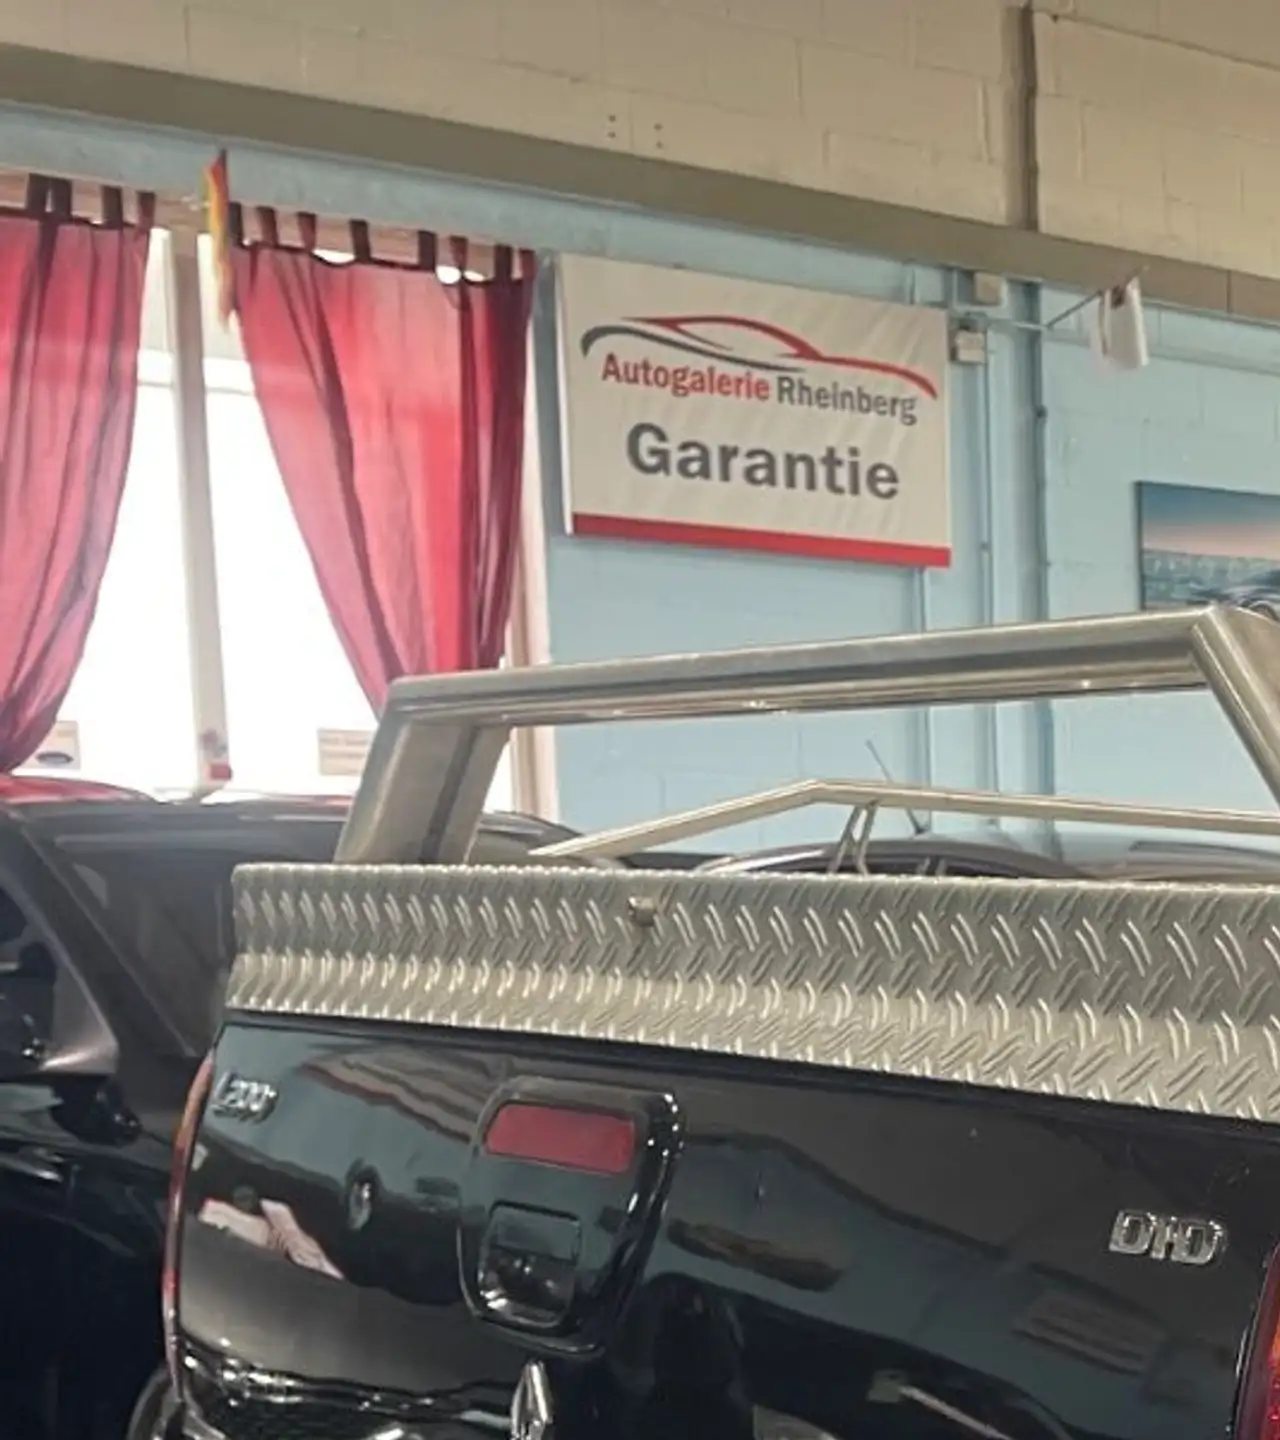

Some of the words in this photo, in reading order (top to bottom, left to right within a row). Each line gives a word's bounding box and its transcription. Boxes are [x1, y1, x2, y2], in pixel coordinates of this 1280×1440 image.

[601, 352, 770, 402] Autogalerie
[776, 376, 918, 426] Rheinberg
[627, 422, 899, 500] Garantie
